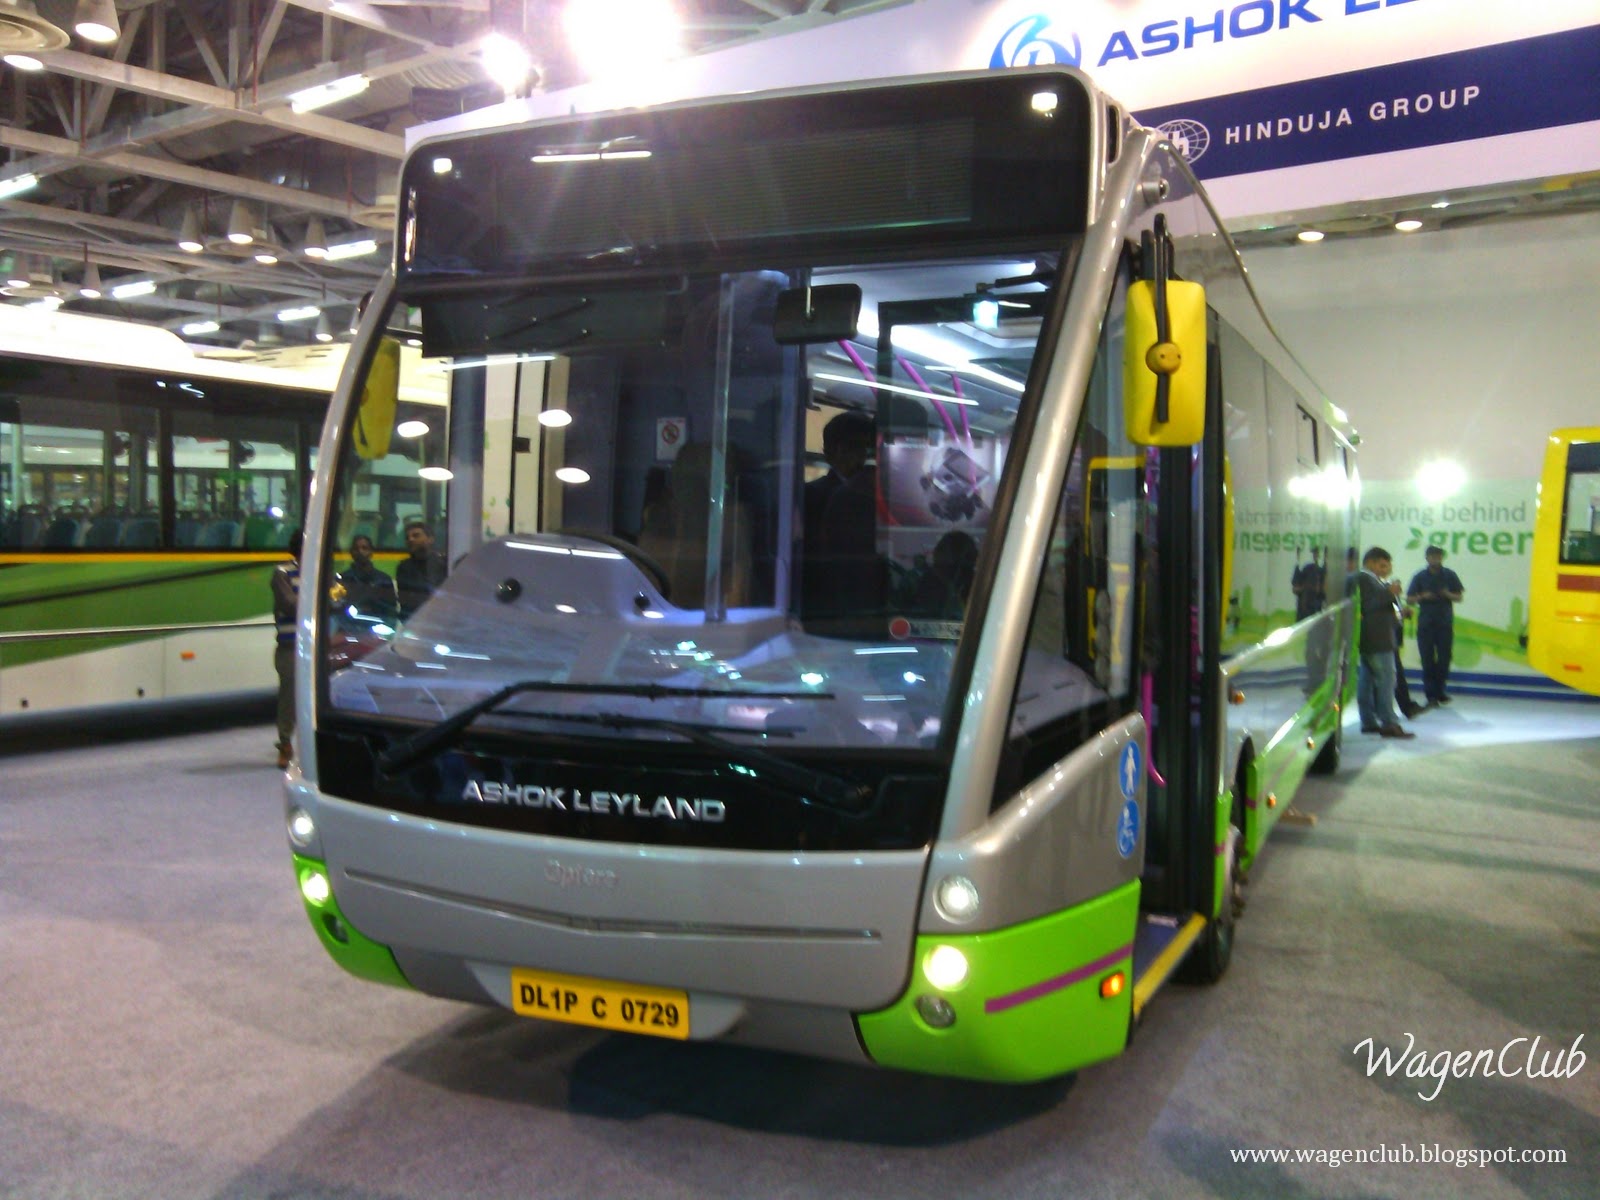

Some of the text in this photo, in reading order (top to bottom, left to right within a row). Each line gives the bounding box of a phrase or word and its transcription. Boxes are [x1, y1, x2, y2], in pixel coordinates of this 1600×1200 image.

[1097, 0, 1323, 67] ASHOK
[1225, 85, 1480, 145] HINDUJA GROUP
[1360, 501, 1526, 527] eaving behind
[462, 779, 726, 823] ASHOK LEYLAND
[519, 982, 680, 1028] DL1P C 0729
